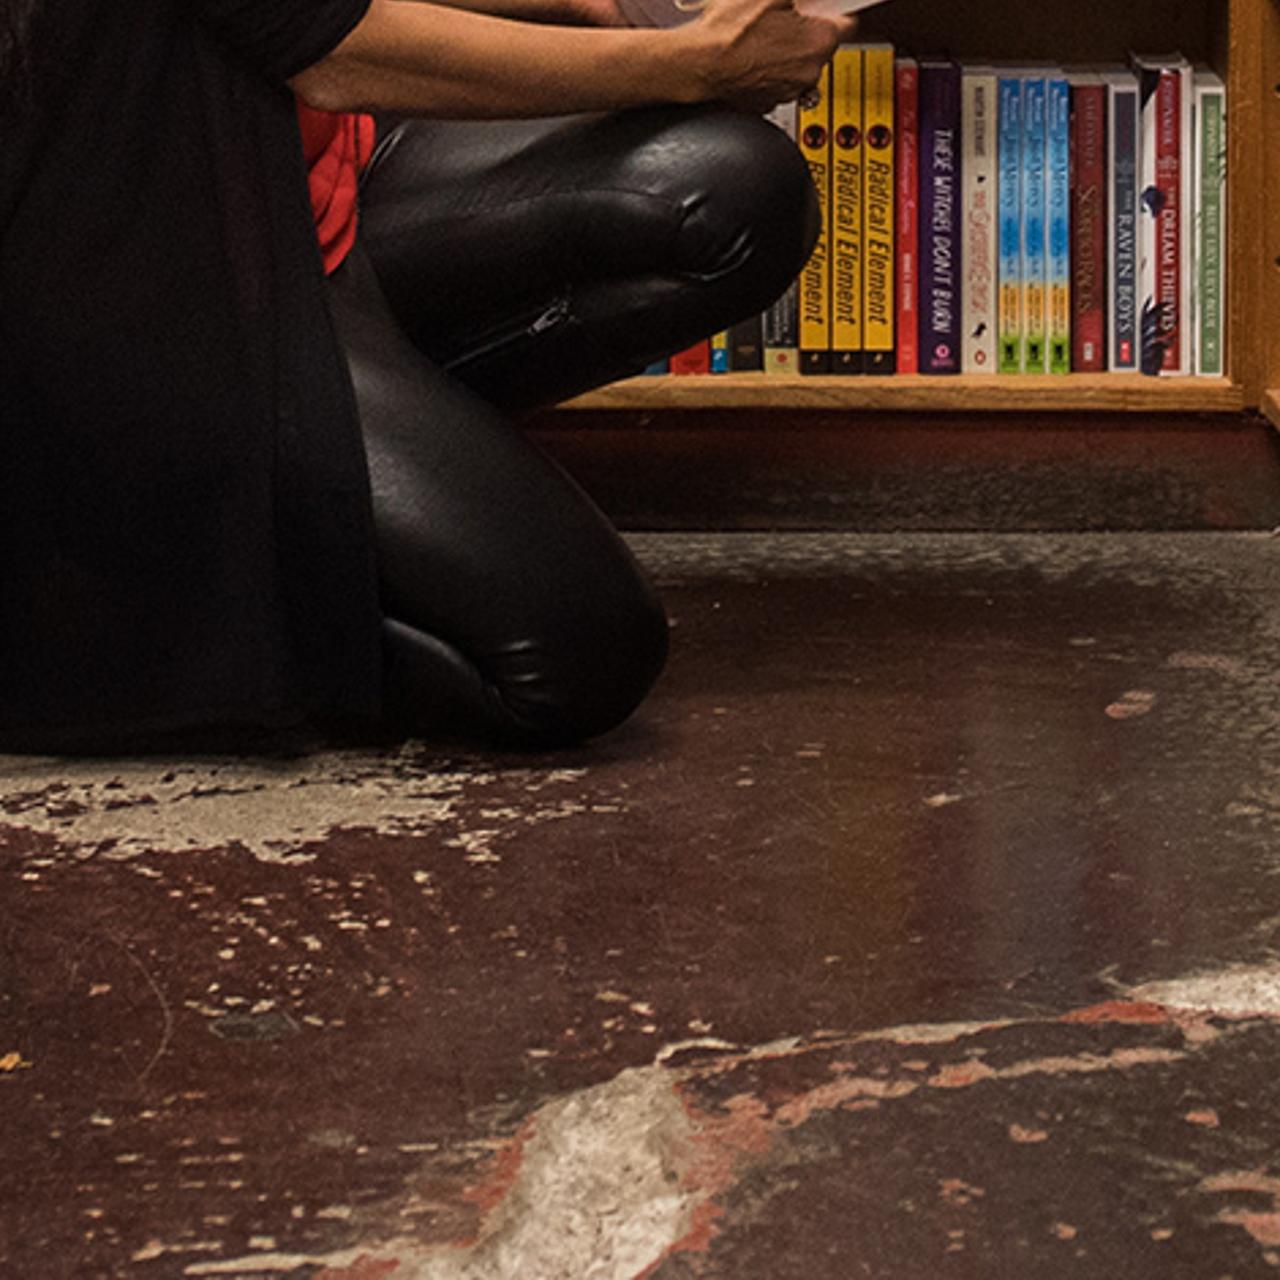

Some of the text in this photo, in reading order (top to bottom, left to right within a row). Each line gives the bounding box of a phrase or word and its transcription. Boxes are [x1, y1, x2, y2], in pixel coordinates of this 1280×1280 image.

[836, 160, 859, 325] Radical Element
[1118, 213, 1133, 333] RAVEN BOYS
